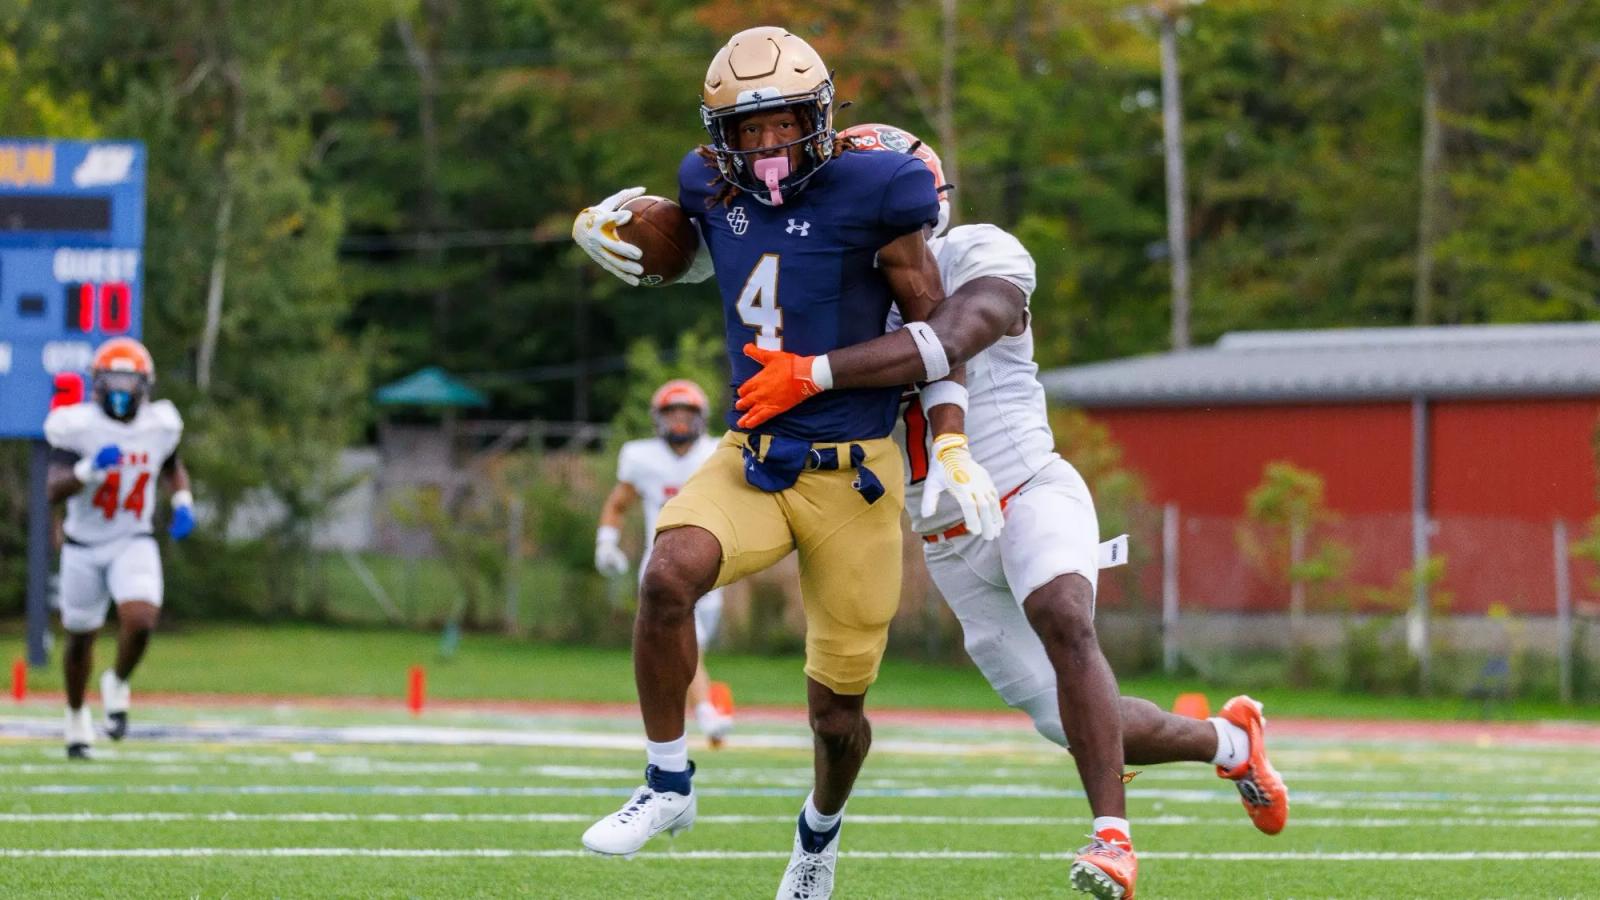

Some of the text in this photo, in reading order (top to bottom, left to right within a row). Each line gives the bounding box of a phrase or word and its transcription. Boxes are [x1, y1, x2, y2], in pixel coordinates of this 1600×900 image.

[79, 281, 131, 332] 10
[736, 252, 783, 351] 4
[92, 470, 150, 522] 44
